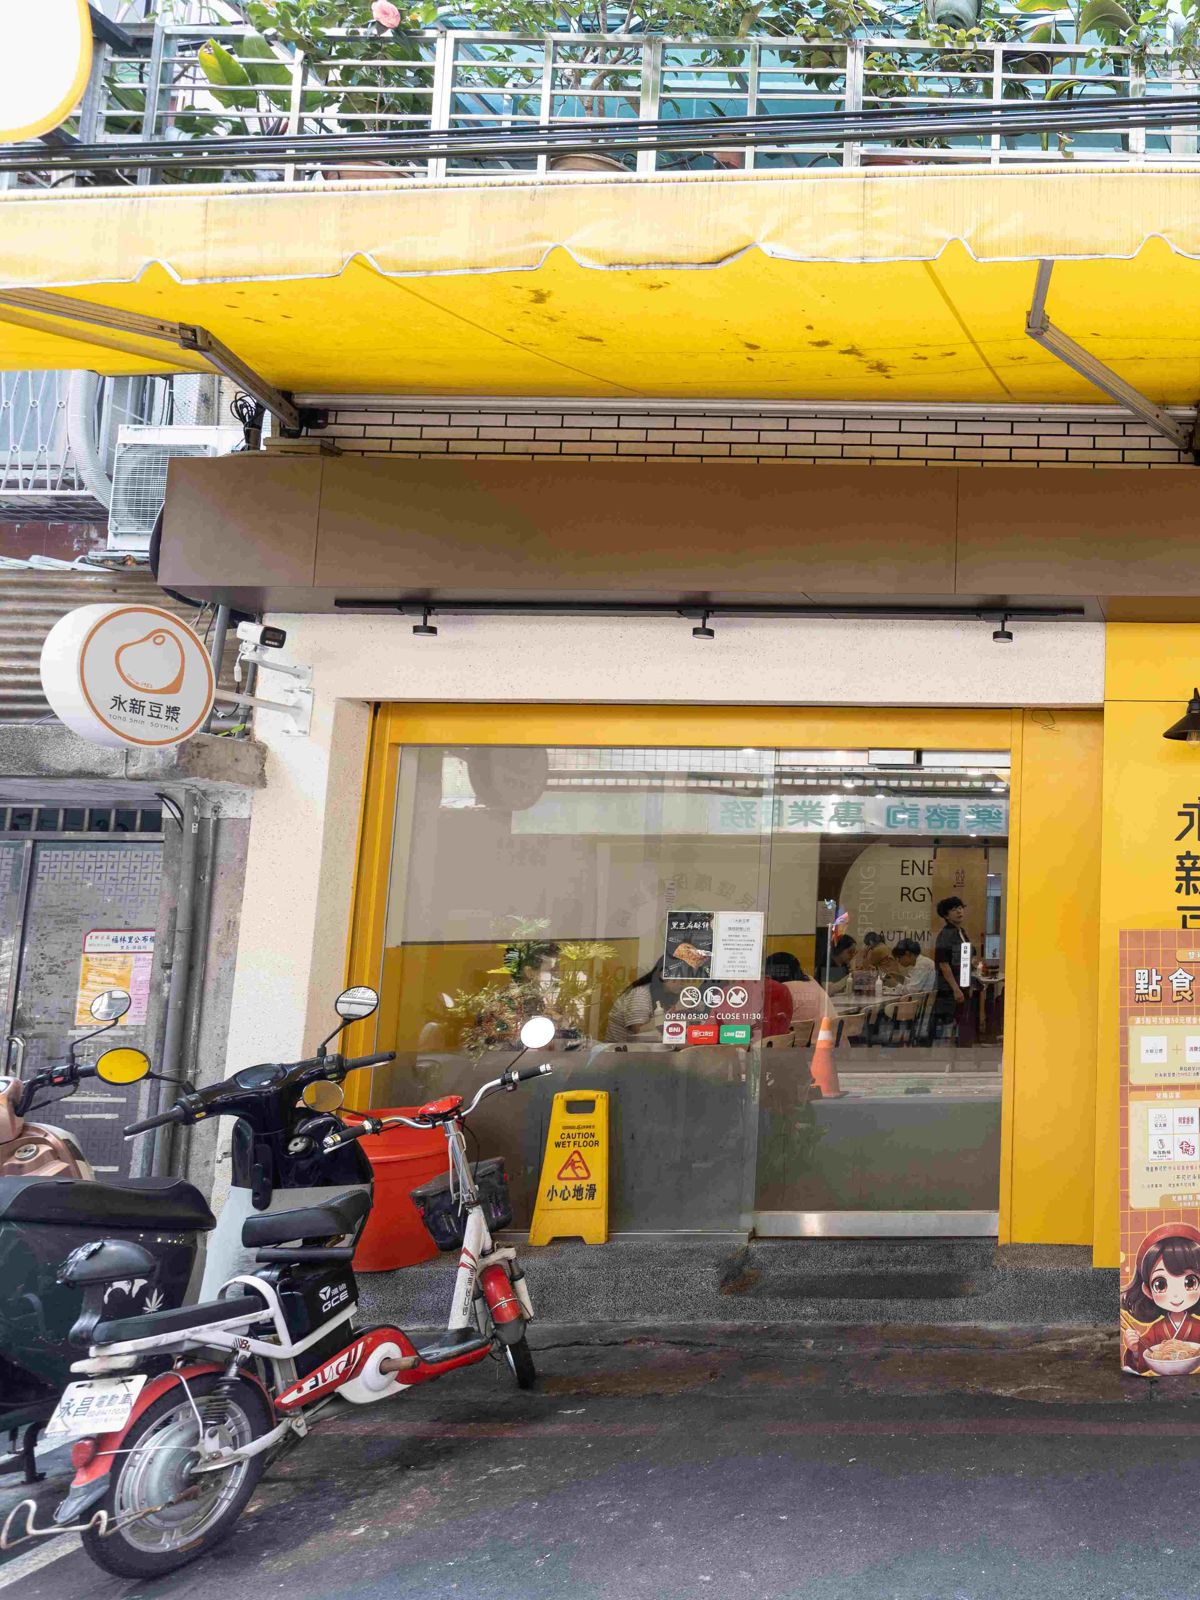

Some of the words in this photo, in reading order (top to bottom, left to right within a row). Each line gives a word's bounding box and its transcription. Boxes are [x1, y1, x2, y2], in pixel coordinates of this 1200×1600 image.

[110, 694, 181, 723] 永新豆漿
[560, 1132, 595, 1140] CAUTION
[573, 1140, 599, 1148] FLOOR
[547, 1184, 596, 1201] 小心地滑
[322, 1290, 349, 1312] GCE
